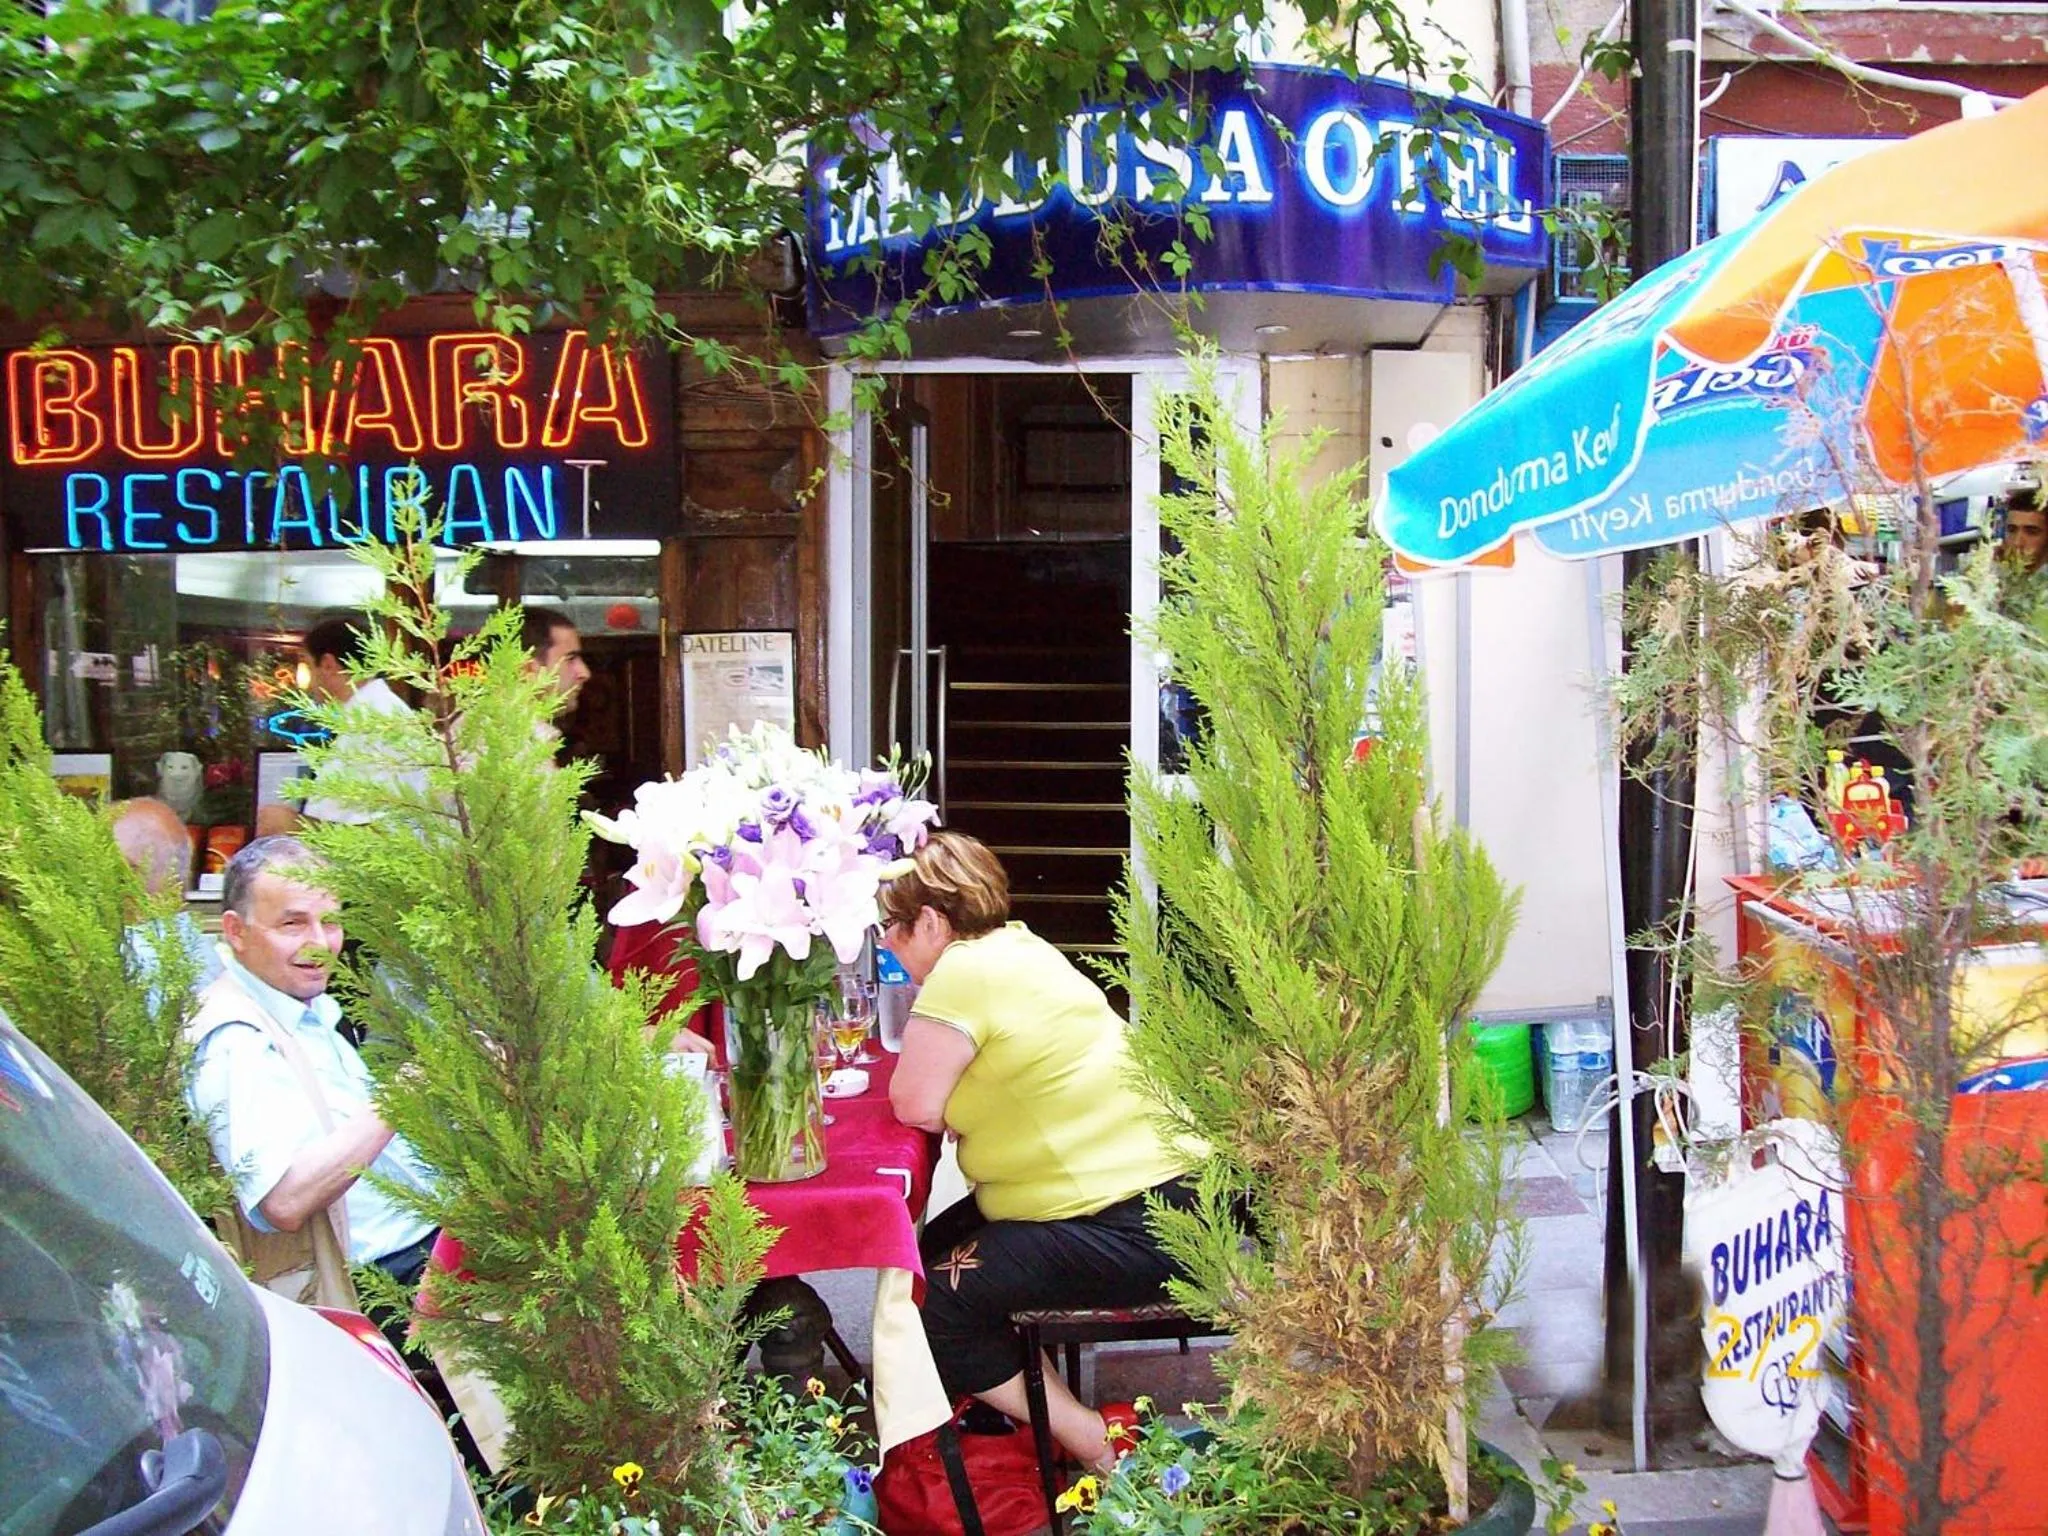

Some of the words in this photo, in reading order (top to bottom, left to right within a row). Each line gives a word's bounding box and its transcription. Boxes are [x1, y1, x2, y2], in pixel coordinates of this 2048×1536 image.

[1305, 110, 1531, 234] OTEL
[7, 331, 649, 464] BUHARA
[66, 460, 608, 549] RESTAURANT
[1438, 452, 1569, 538] Dondurma
[681, 634, 774, 653] DATELINE
[1711, 1188, 1831, 1306] BUHARA
[1718, 1271, 1836, 1371] RESTAURANT
